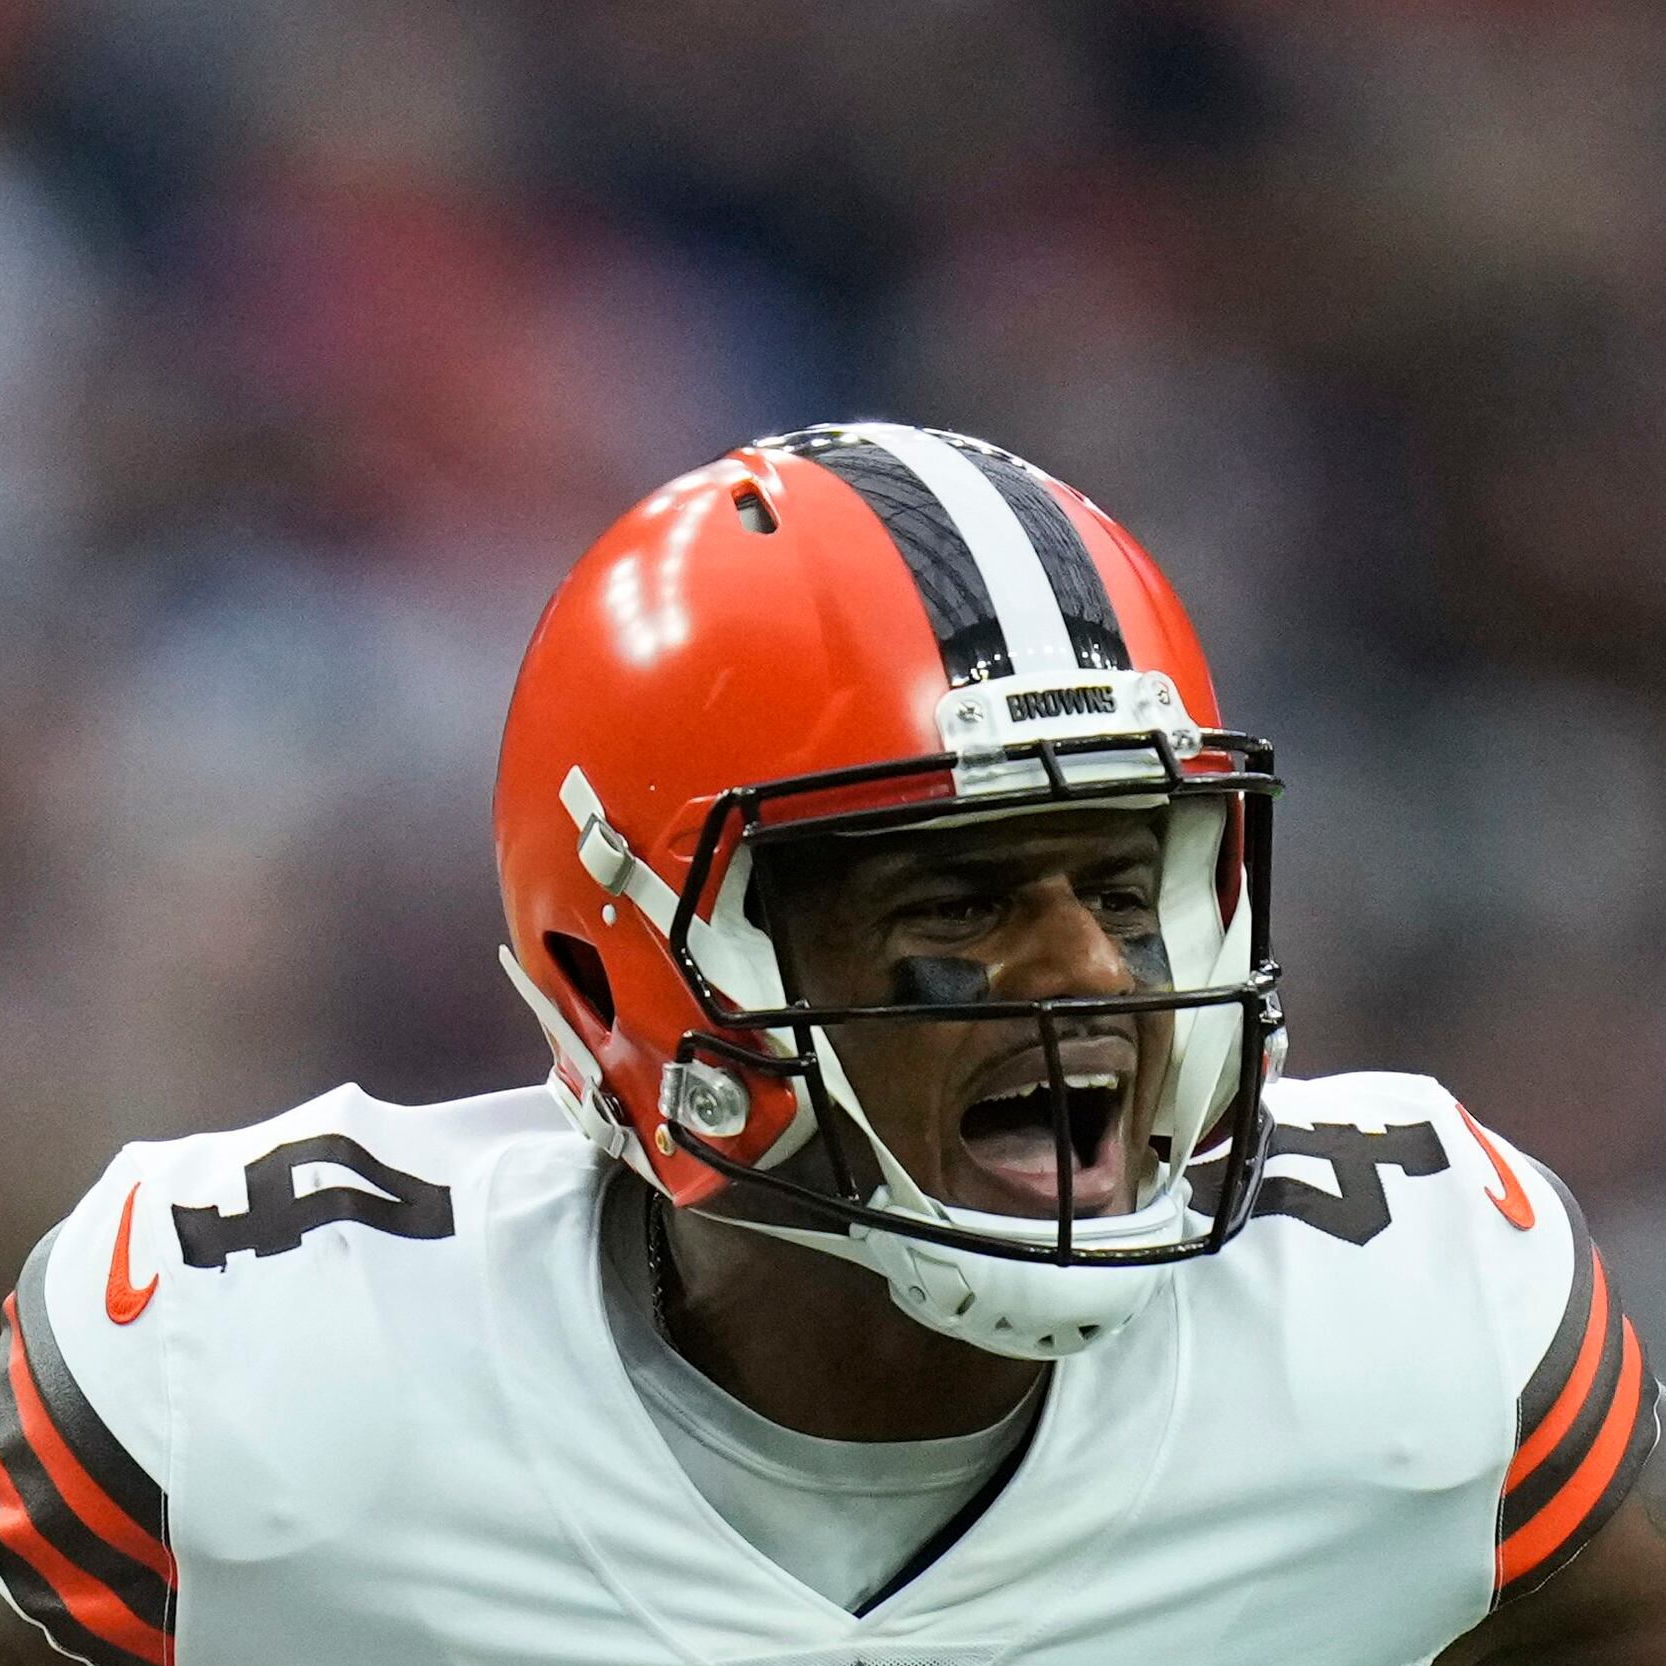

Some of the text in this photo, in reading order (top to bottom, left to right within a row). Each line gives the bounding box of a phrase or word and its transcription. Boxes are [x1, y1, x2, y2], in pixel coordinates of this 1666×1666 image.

[1006, 685, 1117, 723] BROWNS
[171, 1133, 455, 1270] 4
[1181, 1120, 1450, 1247] 4
